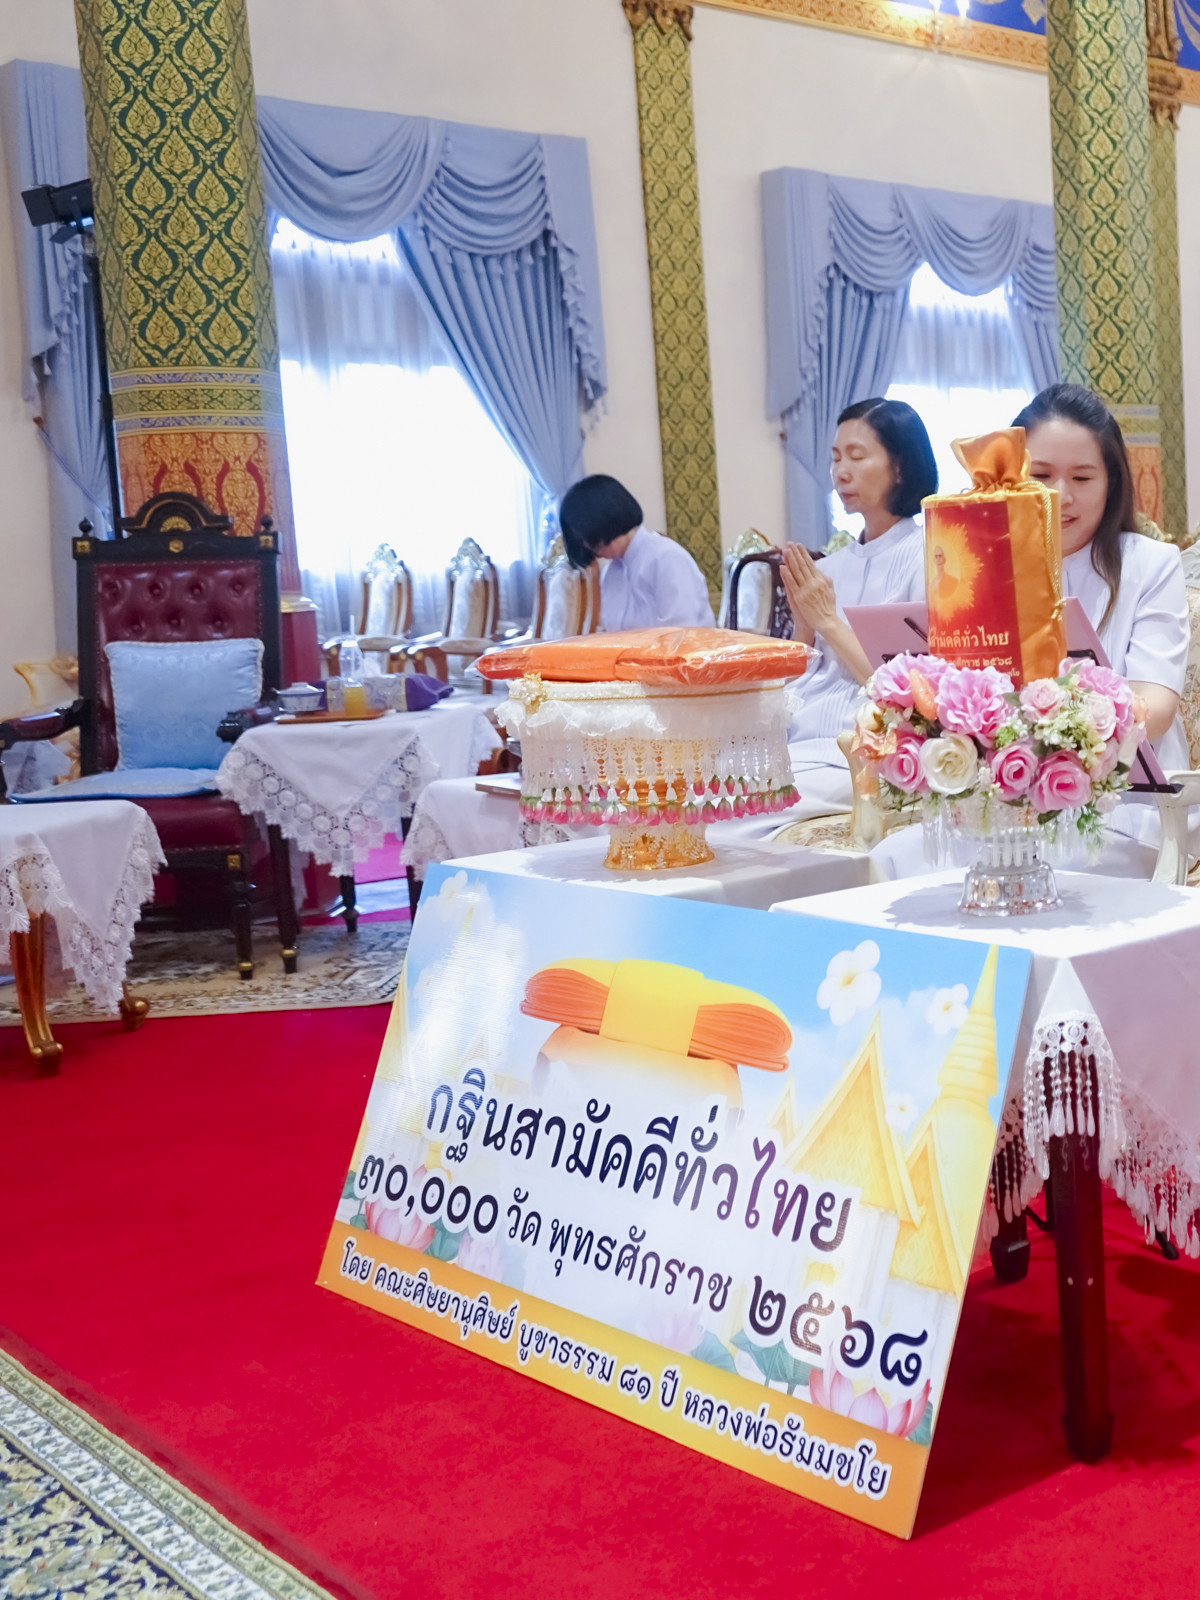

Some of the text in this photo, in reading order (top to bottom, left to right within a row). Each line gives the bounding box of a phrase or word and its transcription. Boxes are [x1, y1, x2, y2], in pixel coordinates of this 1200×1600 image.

[358, 1154, 928, 1387] ๓๐,๐๐๐ วัด พุทธศักราช ๒๕๖๘
[427, 1067, 852, 1252] กฐินสามัคคีทั่วไทย
[341, 1241, 888, 1494] โดย คณะศิษยานุศิษย์ บูชาธรรม ๘๑ ปี หลวงพ่อธัมมชโย
